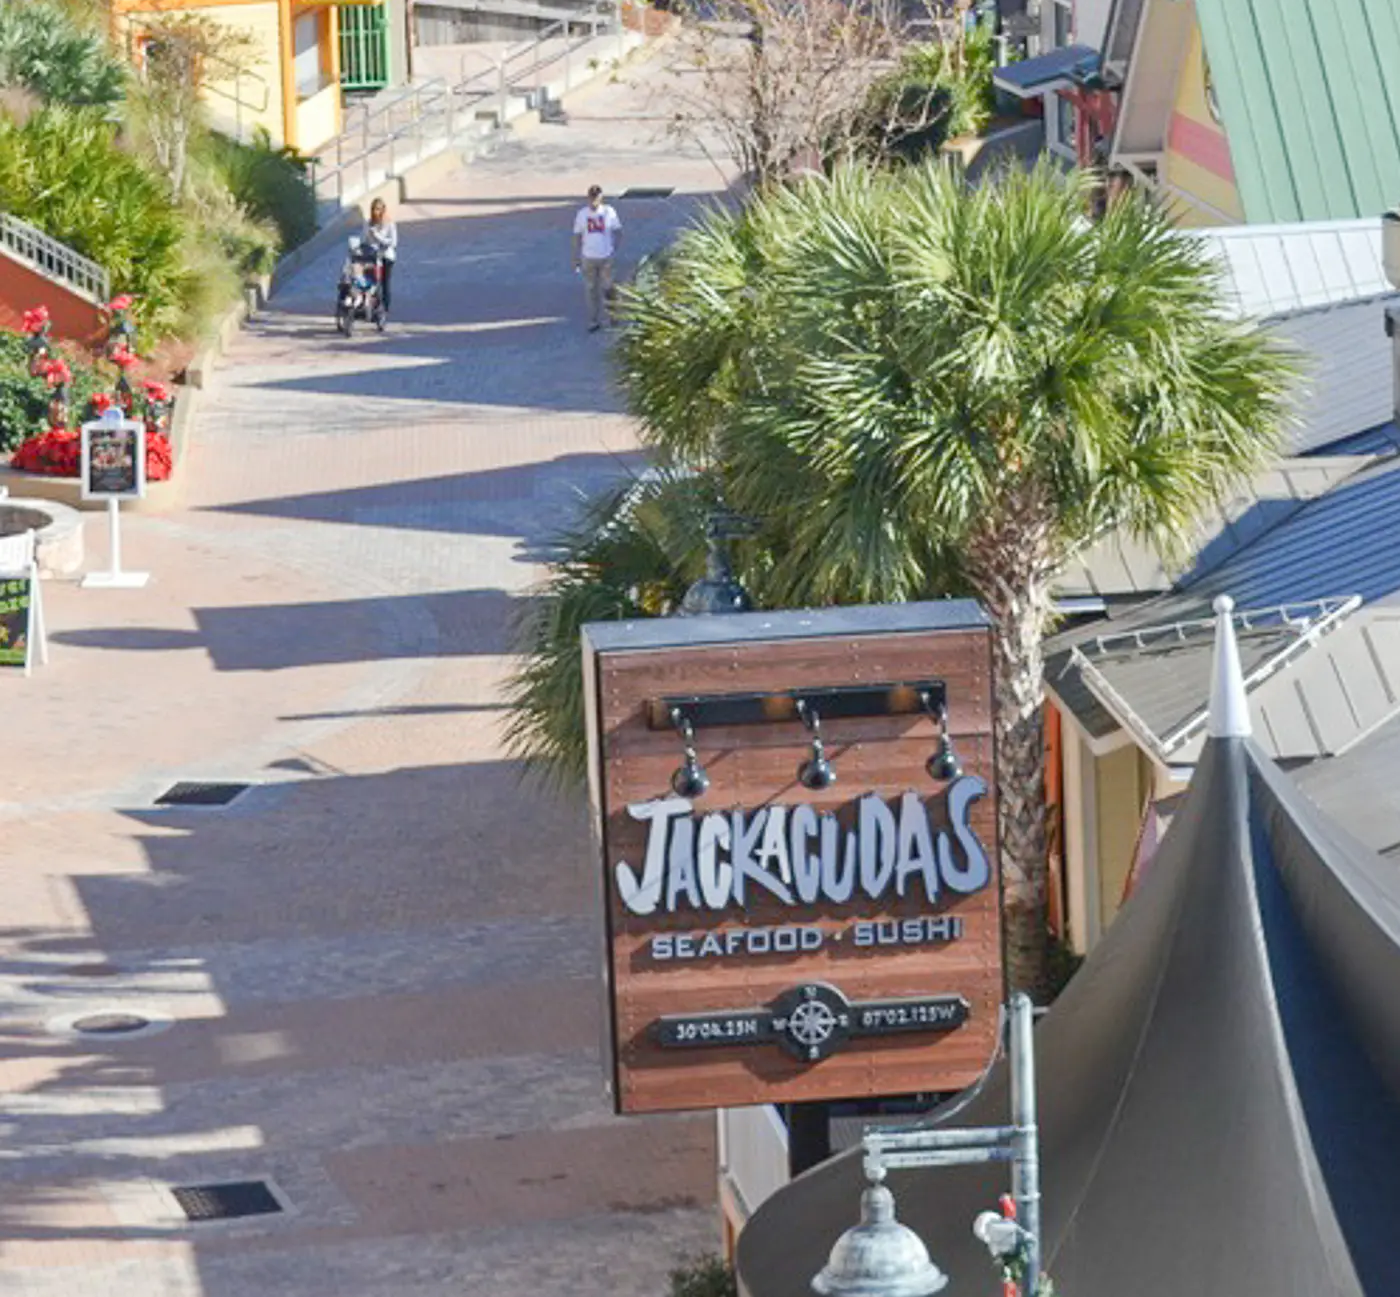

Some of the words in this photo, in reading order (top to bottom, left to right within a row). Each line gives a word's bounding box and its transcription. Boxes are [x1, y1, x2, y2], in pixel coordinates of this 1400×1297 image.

[615, 775, 991, 915] JACKACUDAS
[651, 925, 824, 960] SEAFOOD
[853, 915, 964, 947] SUSHI
